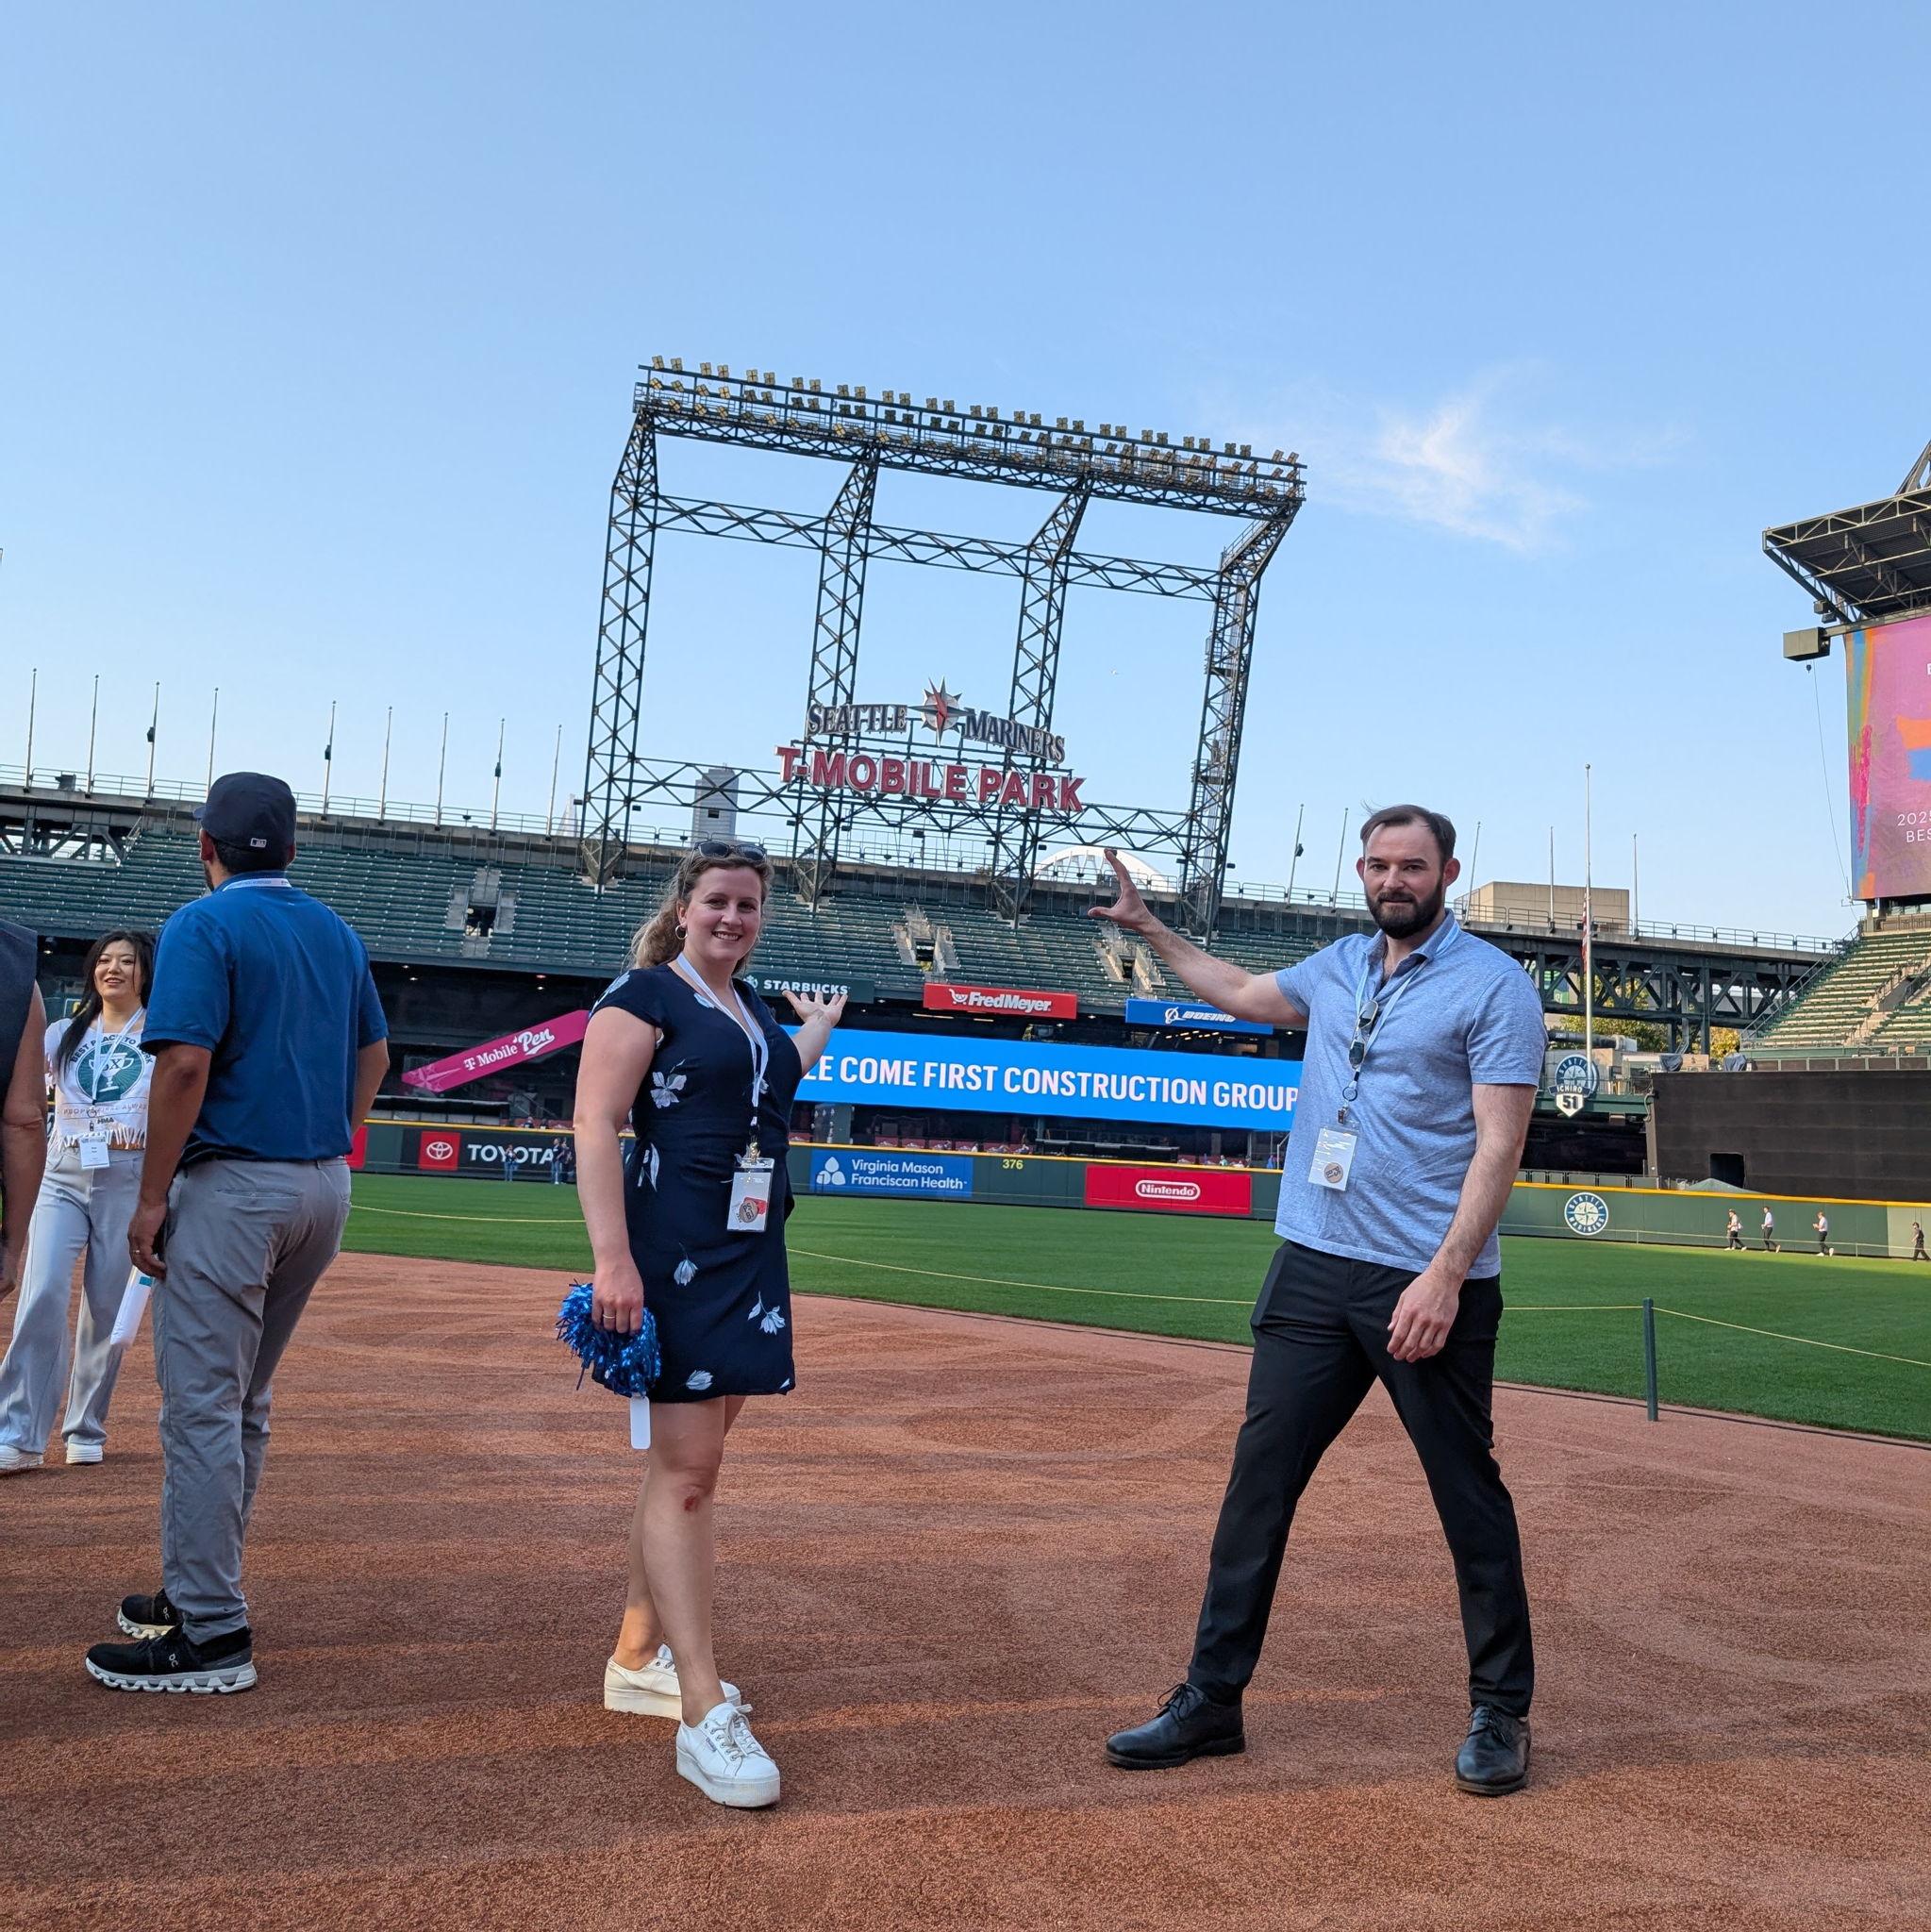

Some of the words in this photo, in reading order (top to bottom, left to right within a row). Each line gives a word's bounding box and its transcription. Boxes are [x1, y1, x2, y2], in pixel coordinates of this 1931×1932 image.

[807, 703, 907, 736] SEATTLE
[965, 707, 1066, 765] MARINERS
[774, 745, 968, 803] T-MOBILE
[977, 766, 1087, 812] PARK
[763, 979, 848, 995] STARBUCKS
[476, 1044, 518, 1067] Mobile
[840, 1057, 918, 1087] COME
[924, 1062, 999, 1091] FIRST
[1004, 1067, 1207, 1106] CONSTRUCTION
[1213, 1081, 1300, 1111] GROUP
[1556, 1085, 1583, 1093] ICHIRO
[1562, 1095, 1579, 1109] 51
[467, 1143, 555, 1165] TOYOTA
[851, 1158, 898, 1174] Virginia
[902, 1161, 943, 1174] Mason
[1002, 1158, 1024, 1170] 376
[851, 1173, 919, 1188] Franciscan
[921, 1176, 964, 1190] Health
[1140, 1183, 1195, 1196] Nintendo
